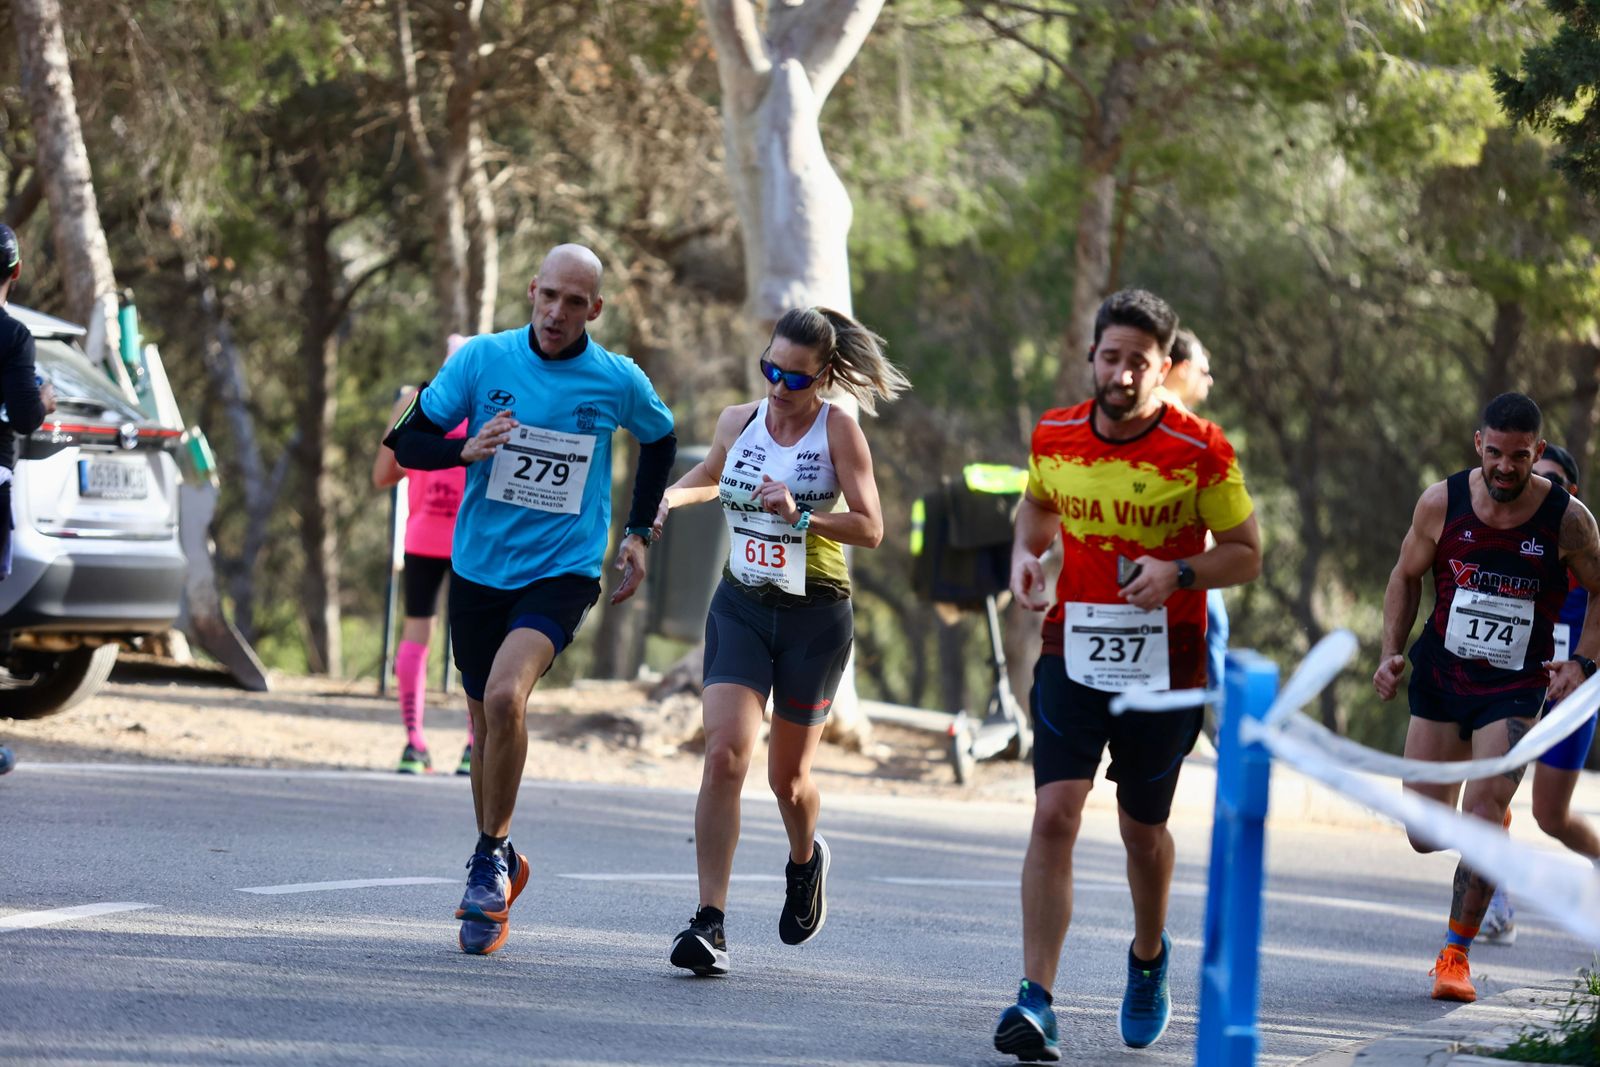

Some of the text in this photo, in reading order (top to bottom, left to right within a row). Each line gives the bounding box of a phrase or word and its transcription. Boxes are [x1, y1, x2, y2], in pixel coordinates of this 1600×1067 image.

[514, 456, 569, 486] 279
[517, 495, 532, 503] PEÑA
[541, 500, 564, 508] BASTÓN
[540, 493, 567, 502] MARATÓN
[795, 490, 834, 502] MÁLAGA
[745, 539, 786, 568] 613
[1466, 619, 1514, 646] 174
[1089, 636, 1146, 663] 237
